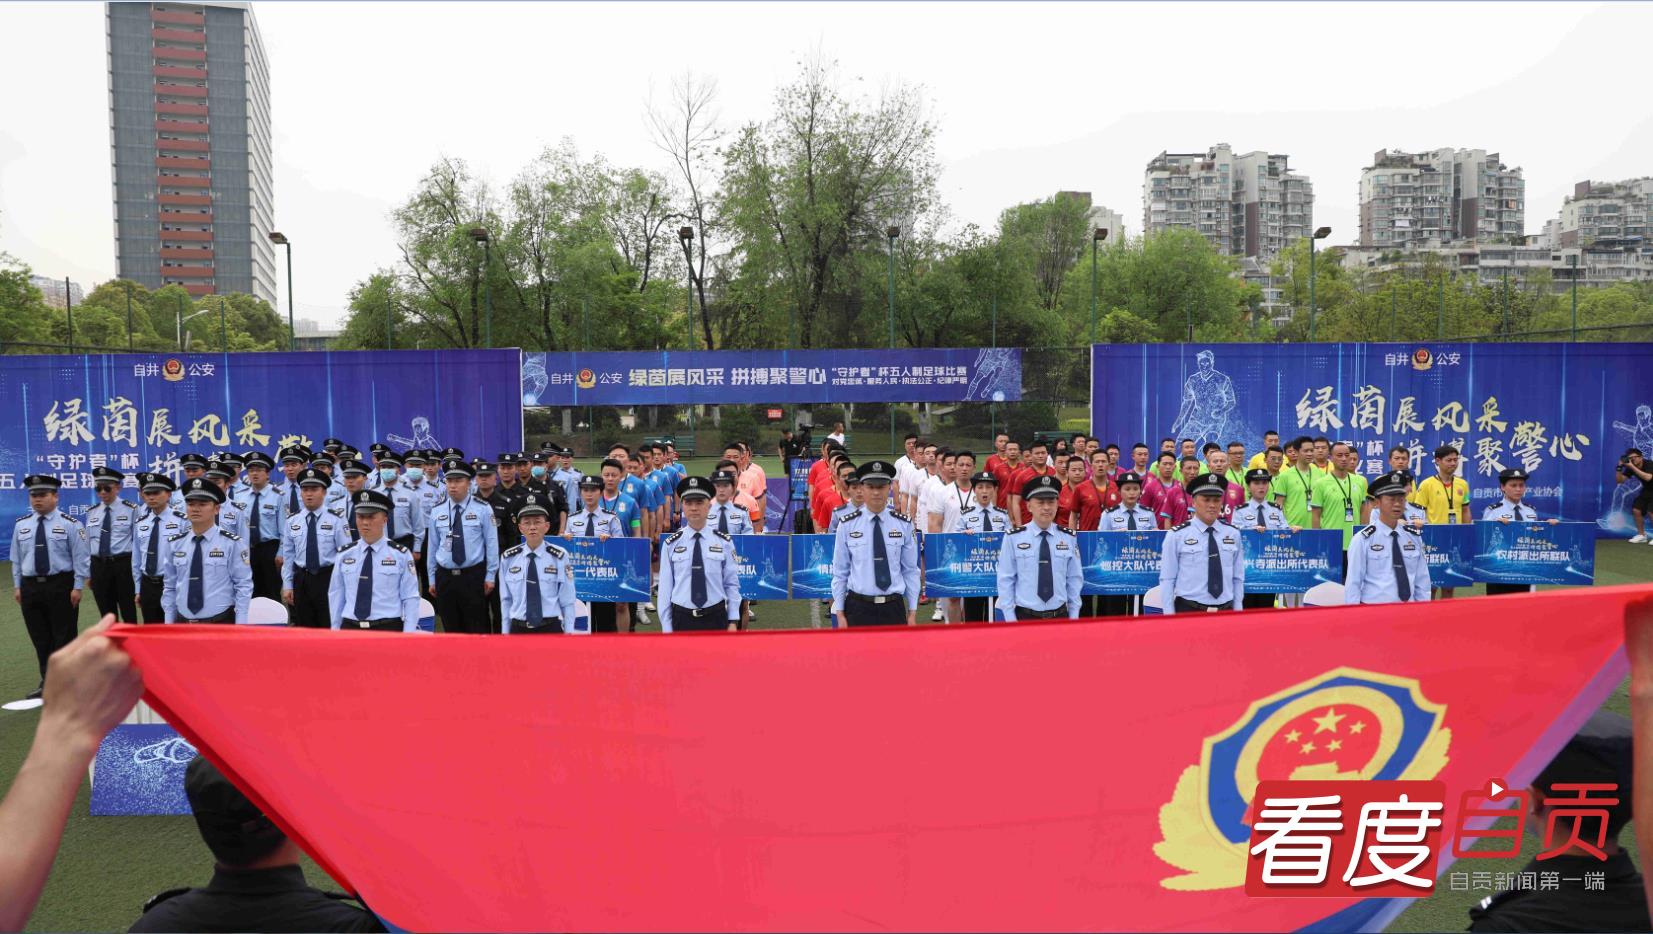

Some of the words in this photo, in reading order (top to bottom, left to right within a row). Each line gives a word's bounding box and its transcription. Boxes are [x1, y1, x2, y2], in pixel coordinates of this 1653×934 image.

[1385, 353, 1408, 366] 自井
[1437, 352, 1461, 365] 公安
[134, 363, 159, 376] 自井
[188, 363, 215, 376] 公安
[551, 373, 573, 385] 自井
[599, 372, 622, 384] 公安
[628, 368, 724, 387] 绿茵展风采
[731, 367, 827, 385] 拼搏聚警心
[1295, 384, 1508, 434] 绿茵展风采
[43, 396, 271, 448] 绿茵展风采
[1474, 486, 1563, 498] 自贡市产业协会
